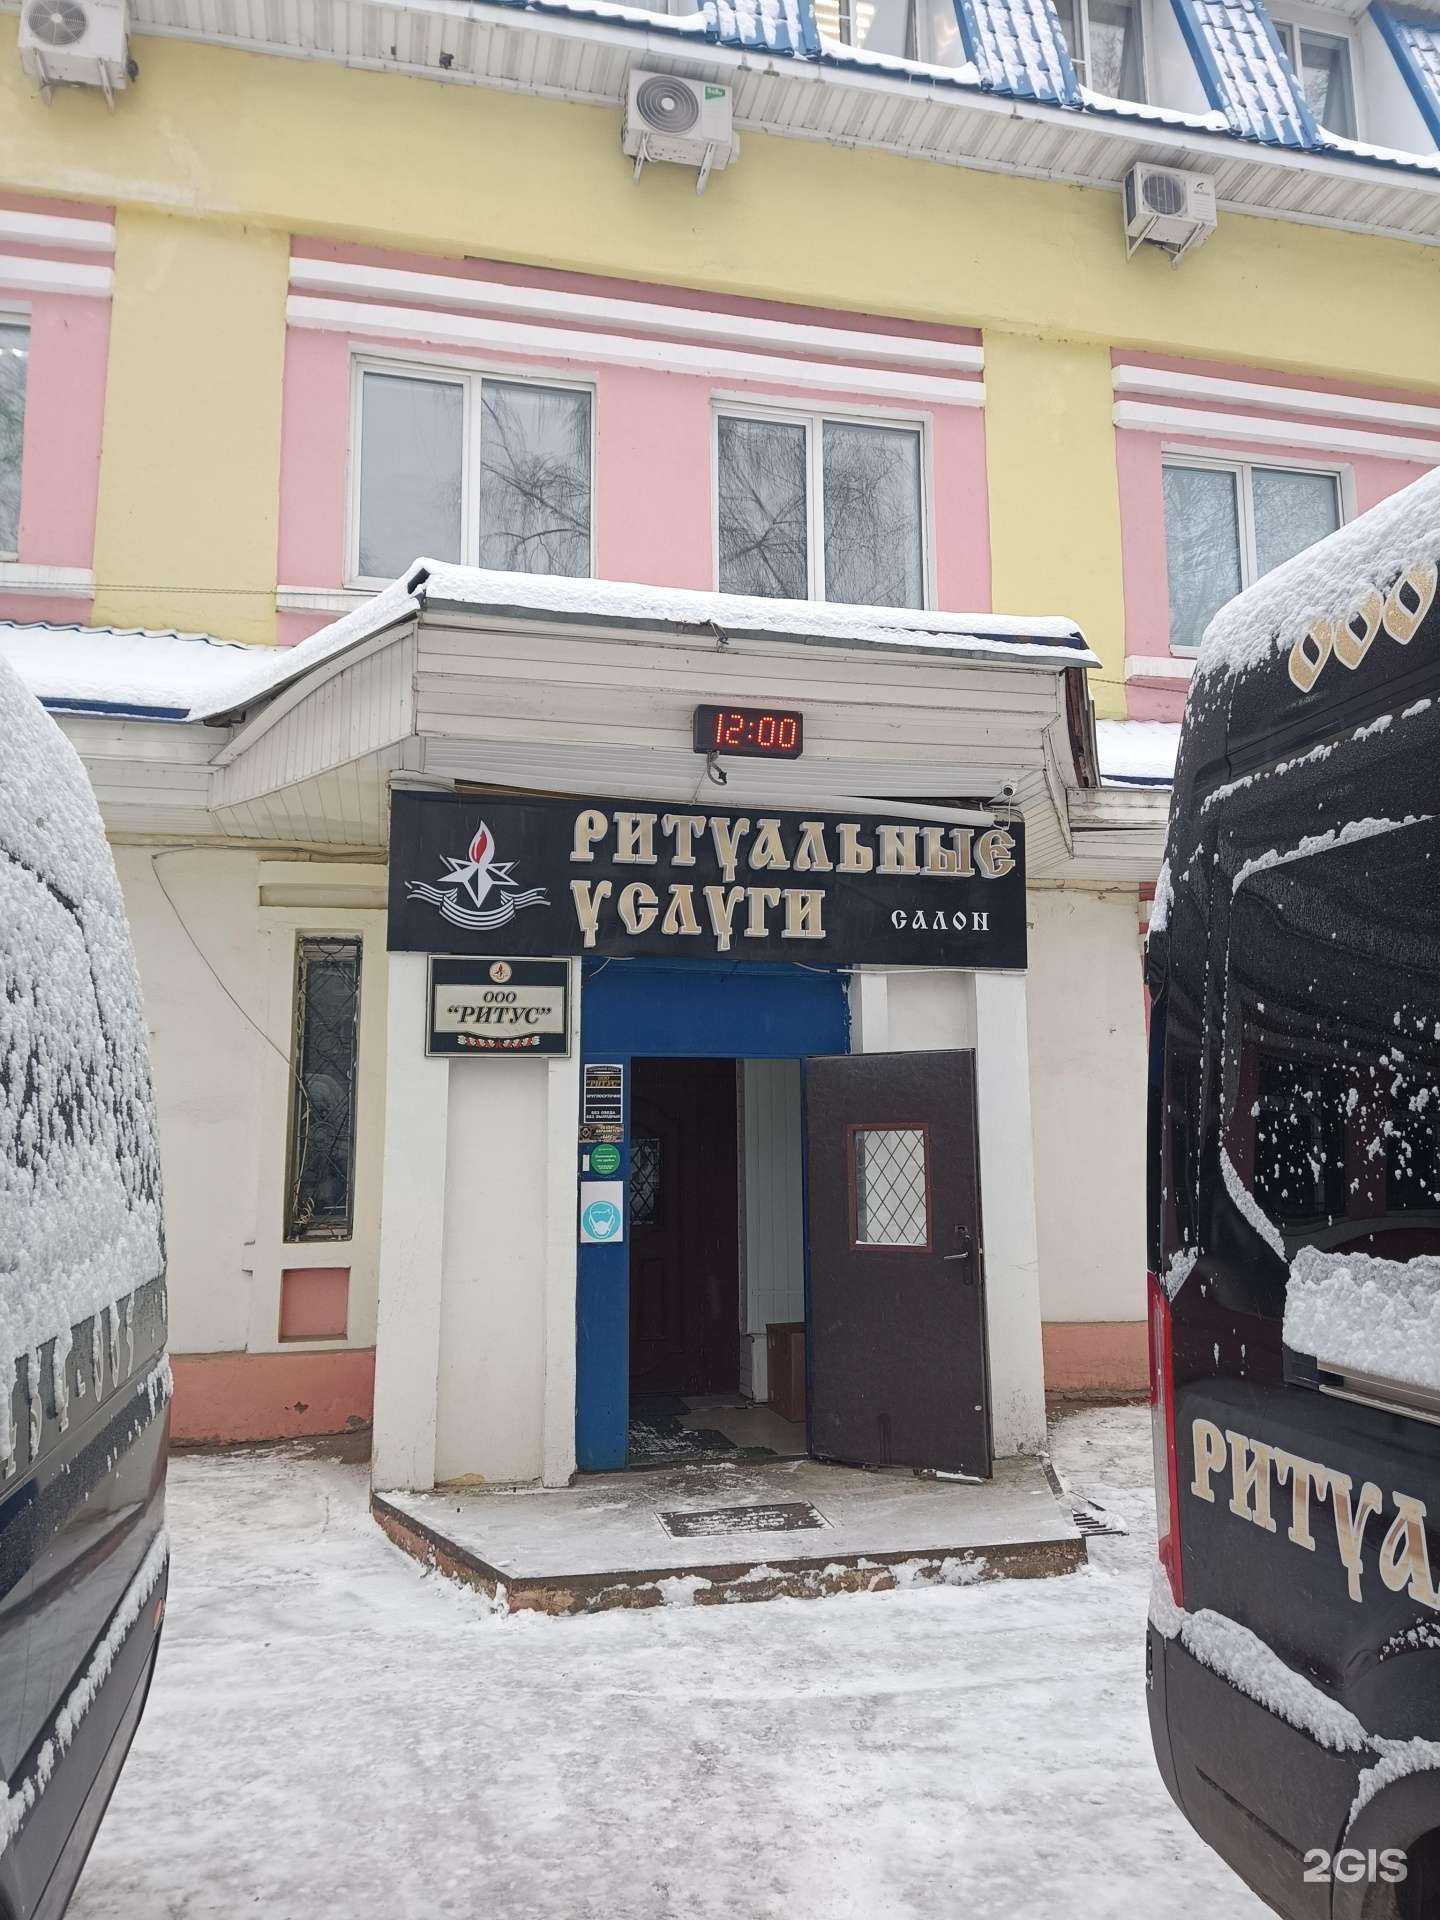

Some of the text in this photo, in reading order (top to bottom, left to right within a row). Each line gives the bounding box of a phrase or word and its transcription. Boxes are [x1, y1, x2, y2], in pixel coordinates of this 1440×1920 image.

[715, 712, 797, 748] 12:00
[570, 809, 1016, 883] РИТУАЛЬНЫЕ
[570, 879, 826, 951] УСЛУГИ
[891, 909, 990, 932] САЛОН
[483, 991, 517, 1003] ООО
[1190, 1418, 1440, 1612] РИТУА
